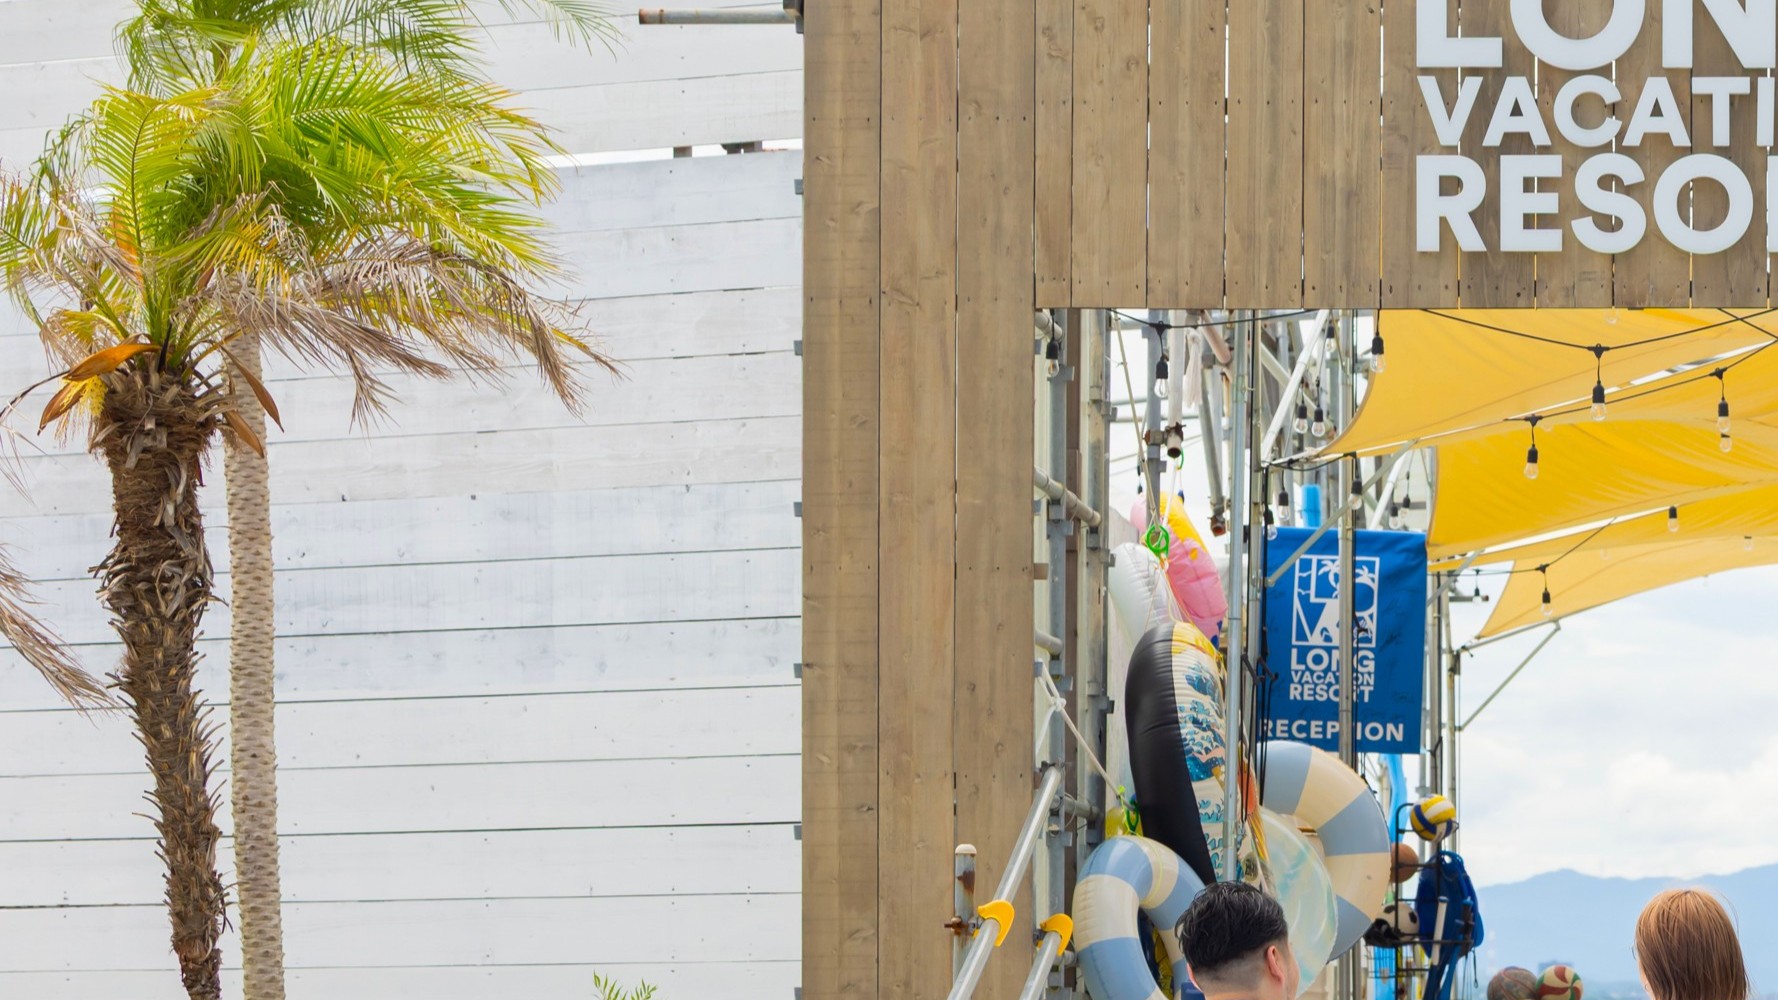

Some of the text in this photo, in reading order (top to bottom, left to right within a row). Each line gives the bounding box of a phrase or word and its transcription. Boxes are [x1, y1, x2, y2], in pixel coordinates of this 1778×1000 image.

[1291, 671, 1375, 685] VACAON
[1289, 684, 1374, 703] RESOT
[1259, 719, 1404, 742] RECEPION
